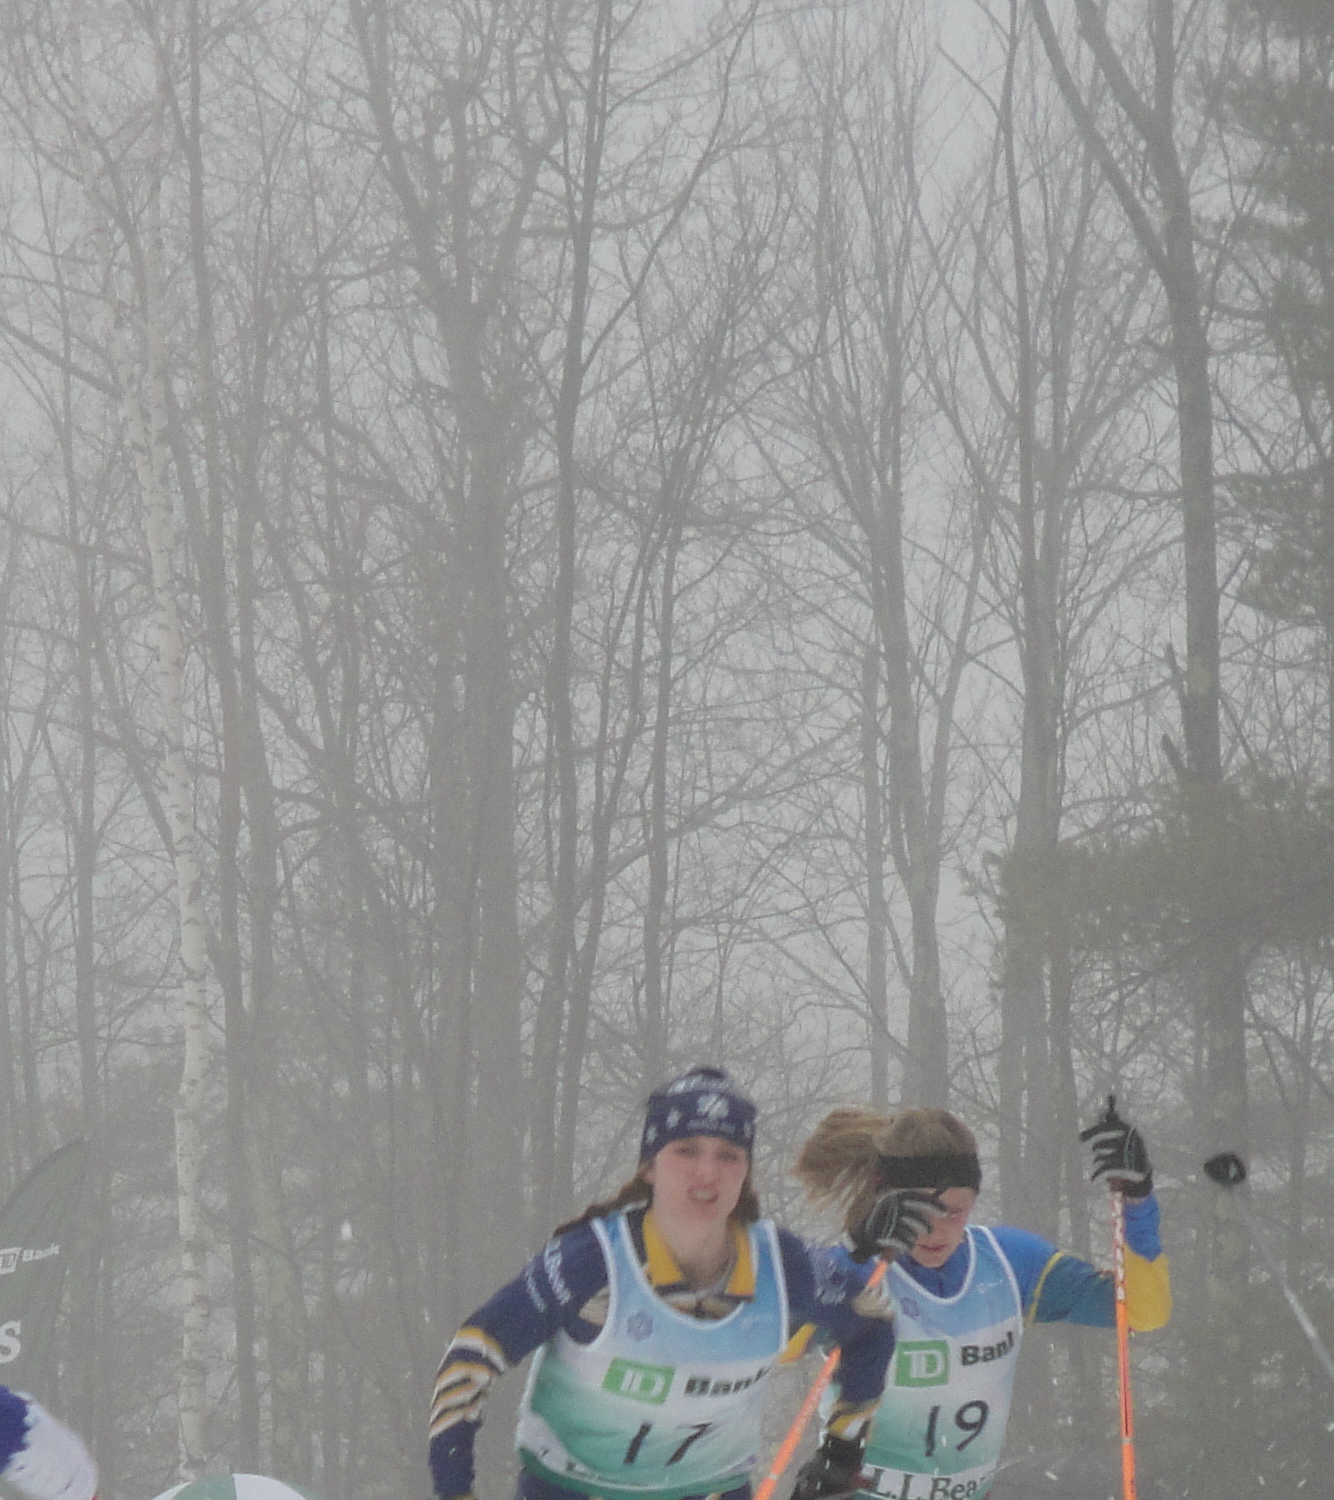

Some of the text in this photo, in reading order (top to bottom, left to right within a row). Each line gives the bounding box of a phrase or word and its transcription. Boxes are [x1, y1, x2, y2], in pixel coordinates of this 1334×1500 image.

[22, 1243, 60, 1262] Bank
[623, 1420, 713, 1467] 17
[925, 1400, 990, 1457] 19
